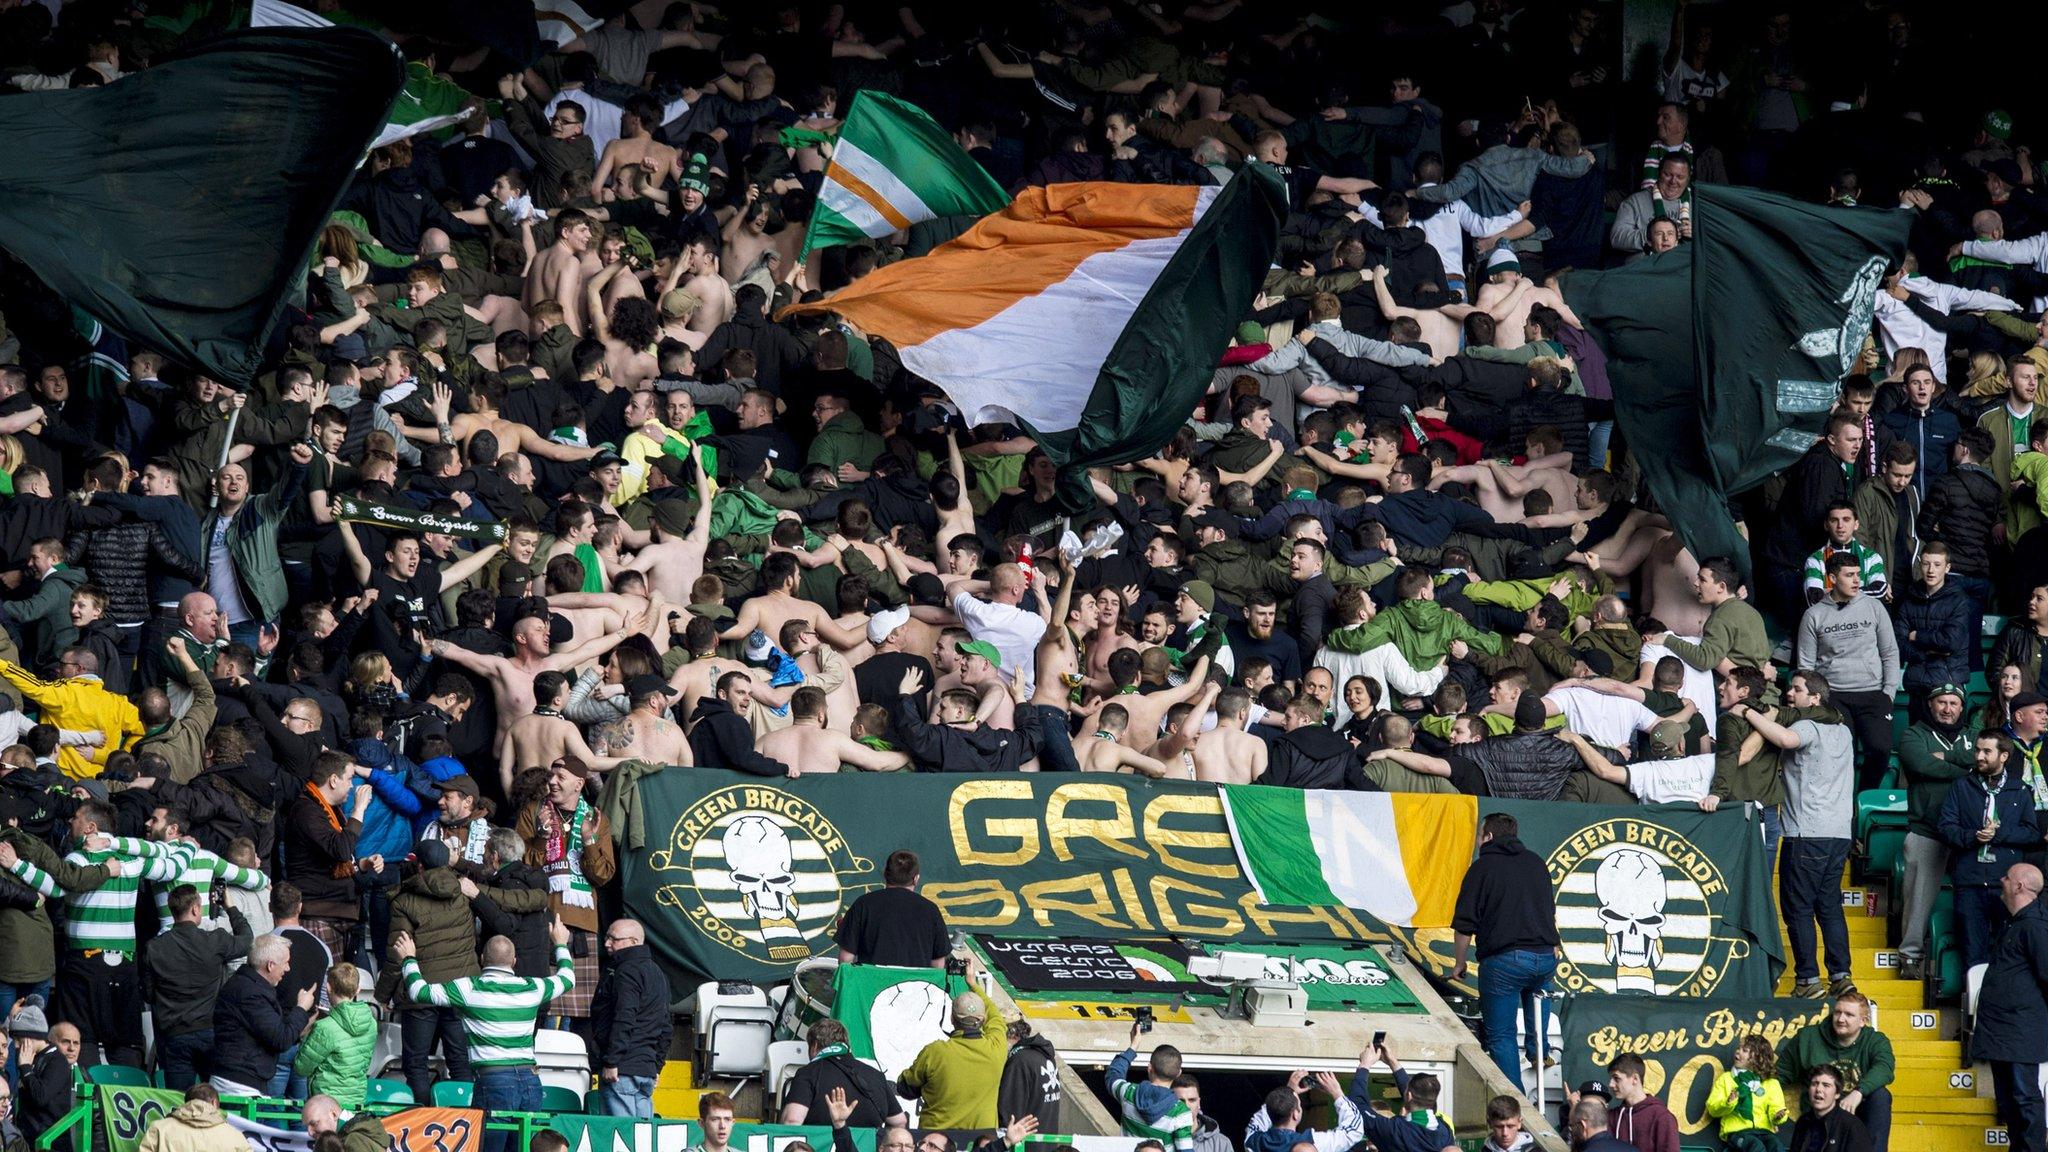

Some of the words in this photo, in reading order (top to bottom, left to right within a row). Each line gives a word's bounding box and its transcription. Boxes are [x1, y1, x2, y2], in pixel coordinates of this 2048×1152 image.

[369, 505, 414, 523] Green
[418, 514, 479, 533] Brigade
[1824, 622, 1859, 633] adidas
[677, 792, 737, 851] GREEN
[744, 789, 843, 854] BRIGADE
[551, 860, 569, 871] PAULI
[1548, 823, 1616, 886] GREEN
[1626, 823, 1723, 896] BRIGADE
[1842, 891, 1862, 905] FF
[690, 906, 747, 948] 2006
[987, 941, 1114, 954] ULTRAS
[1019, 955, 1128, 967] CELTIC
[1877, 953, 1898, 967] EE
[1049, 968, 1137, 980] 2006
[1323, 973, 1388, 987] Celtic
[1912, 1014, 1935, 1027] DD
[1587, 1025, 1689, 1066] Green
[1695, 1003, 1830, 1058] Brigad
[1950, 1073, 1973, 1087] CC
[1986, 1130, 2009, 1143] BB
